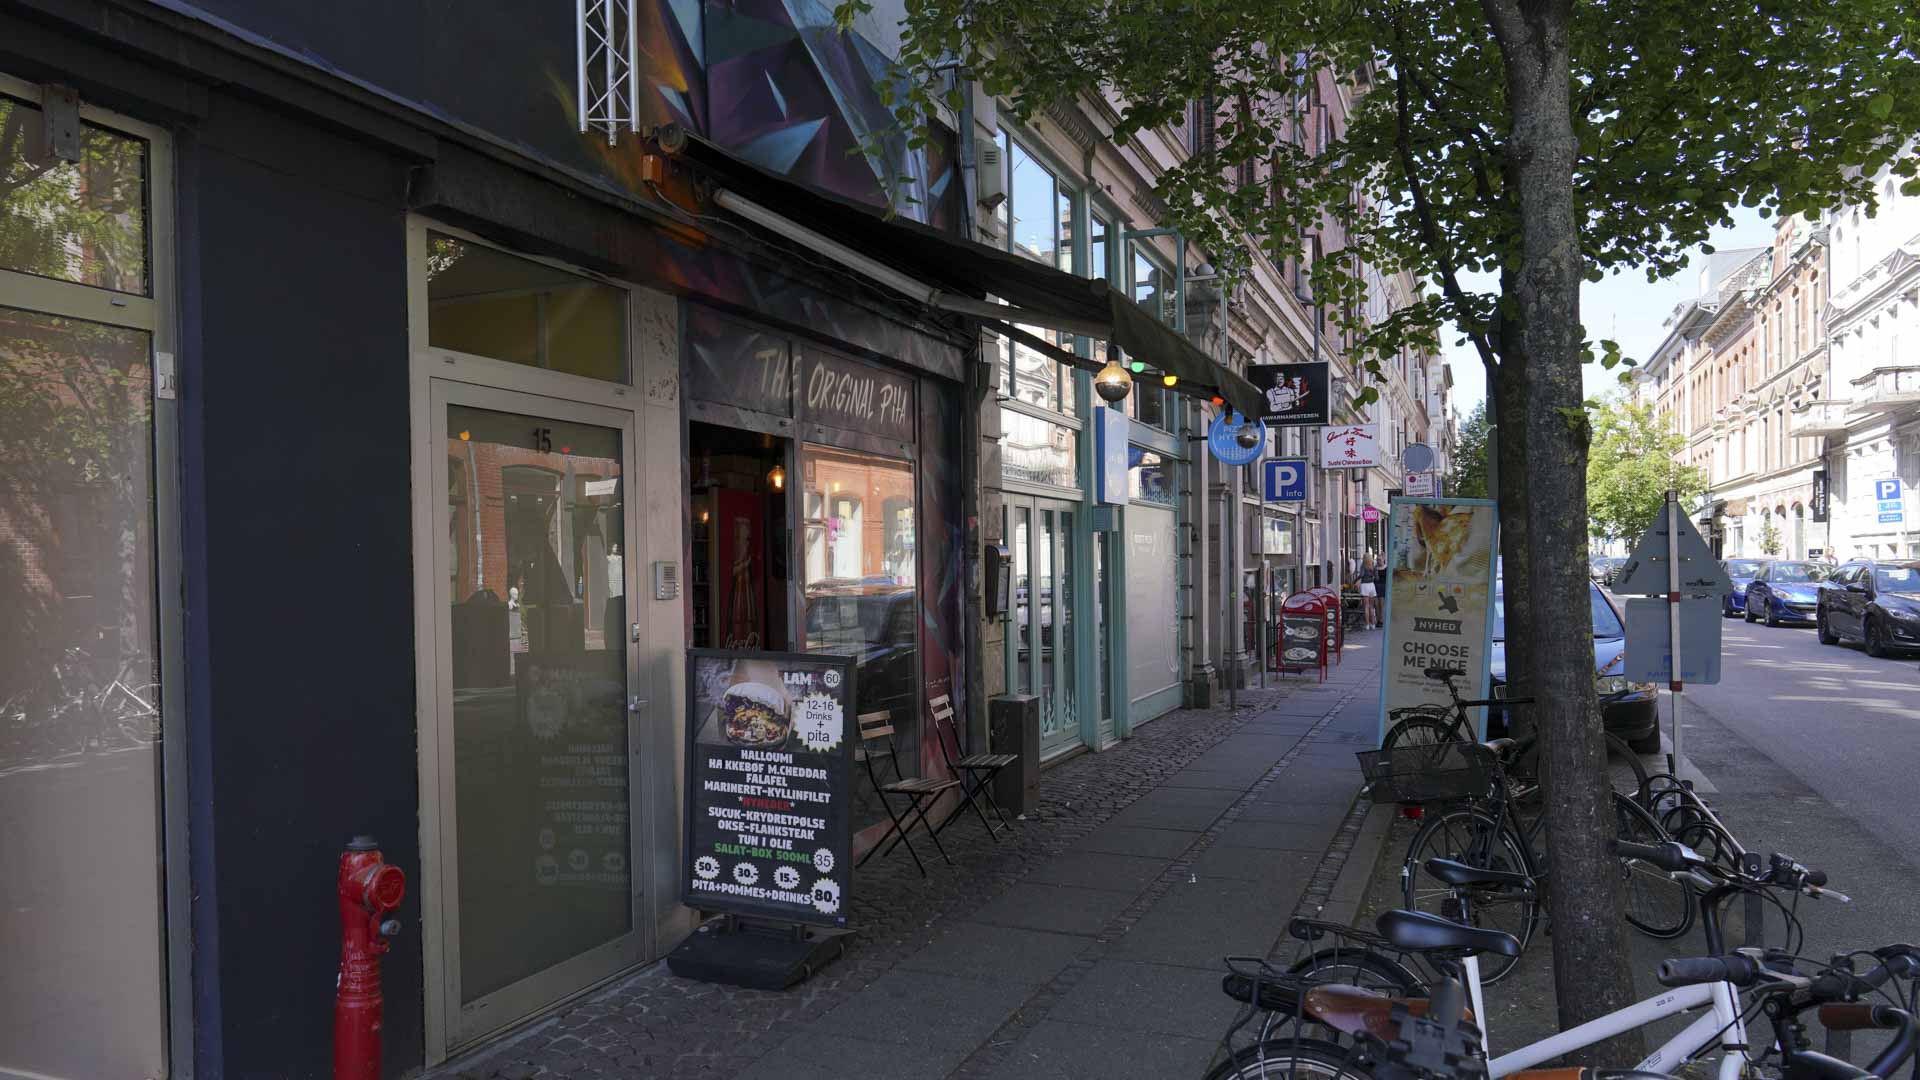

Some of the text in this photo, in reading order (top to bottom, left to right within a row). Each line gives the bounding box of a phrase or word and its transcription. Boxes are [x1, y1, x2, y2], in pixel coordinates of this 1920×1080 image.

[533, 429, 552, 454] 15
[1275, 466, 1298, 497] P
[1881, 482, 1897, 499] P
[1419, 621, 1456, 631] NYHED
[1403, 642, 1469, 658] CHOOSE
[1403, 656, 1467, 671] ME NICE
[825, 673, 839, 684] 60
[807, 701, 834, 711] 12-16
[806, 711, 833, 721] Drinks
[807, 730, 830, 743] pita
[741, 749, 793, 764] HALLOUMI
[746, 773, 788, 787] FALAFEL
[767, 764, 827, 780] M.CHEDDAR
[708, 806, 826, 830] SUCUK-KRYDRETPØLSE
[718, 820, 815, 840] OKSE-FLANKSTEAK
[738, 834, 793, 850] TUN I OLIE
[714, 842, 812, 864] SALAT-BOX 500ML
[815, 854, 831, 868] 35
[692, 880, 812, 905] PITA+POMMES+DRINKS
